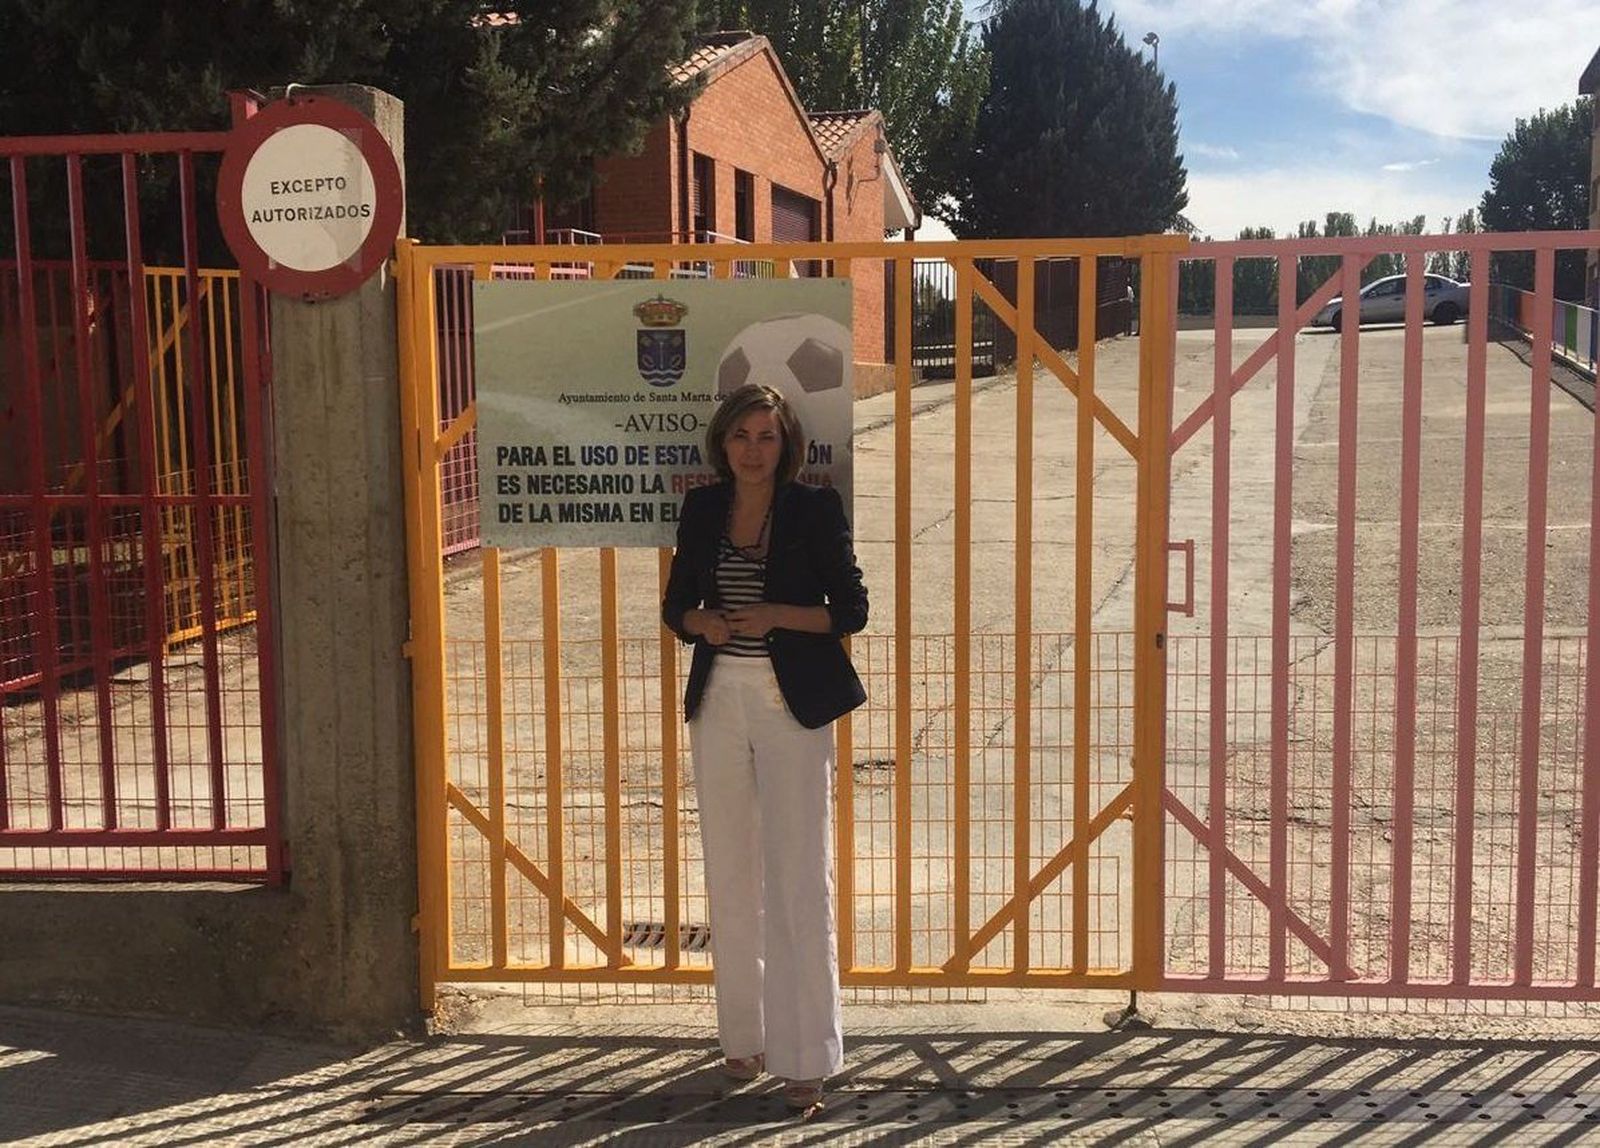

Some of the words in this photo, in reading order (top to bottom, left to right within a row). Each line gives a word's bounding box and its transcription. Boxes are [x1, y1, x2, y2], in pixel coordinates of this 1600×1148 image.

[270, 176, 347, 195] EXCEPTO
[252, 204, 371, 223] AUTORIZADOS
[558, 392, 630, 405] Ayuntamiento
[633, 392, 646, 403] de
[650, 391, 678, 402] Santa
[681, 391, 711, 402] Marta
[615, 412, 708, 433] -AVISO-
[497, 446, 547, 466] PARA
[553, 446, 576, 466] EL
[581, 445, 618, 466] USO
[625, 445, 649, 466] DE
[655, 445, 702, 466] ESTA
[497, 475, 521, 495] ES
[527, 474, 634, 495] NECESARIO
[640, 474, 665, 494] LA
[499, 503, 523, 523] DE
[528, 503, 553, 523] LA
[558, 503, 624, 523] MISMA
[629, 503, 654, 522] EN
[660, 502, 680, 522] EL
